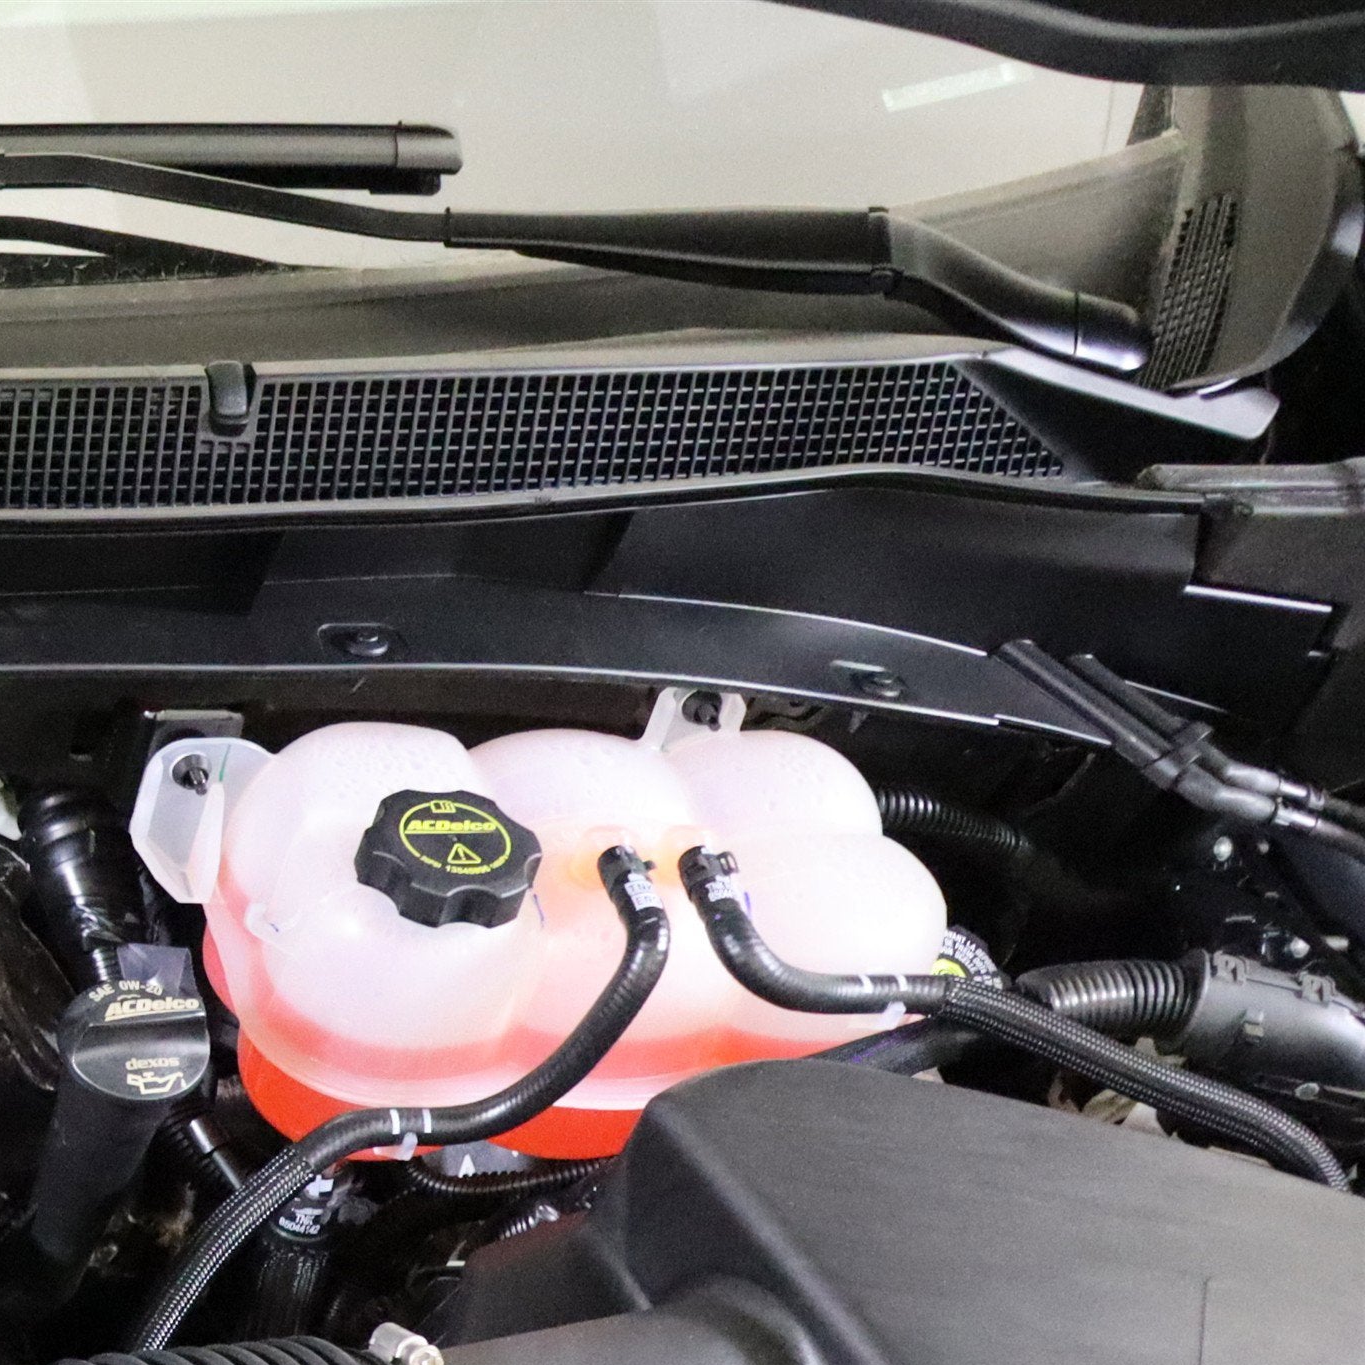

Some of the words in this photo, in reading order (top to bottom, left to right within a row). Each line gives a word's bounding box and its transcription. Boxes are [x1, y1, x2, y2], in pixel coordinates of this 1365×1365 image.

[405, 820, 497, 833] ACDelco
[89, 983, 115, 1002] SAE
[119, 980, 164, 996] 0W-20
[105, 997, 200, 1020] ACDelco
[125, 1057, 180, 1071] dexos
